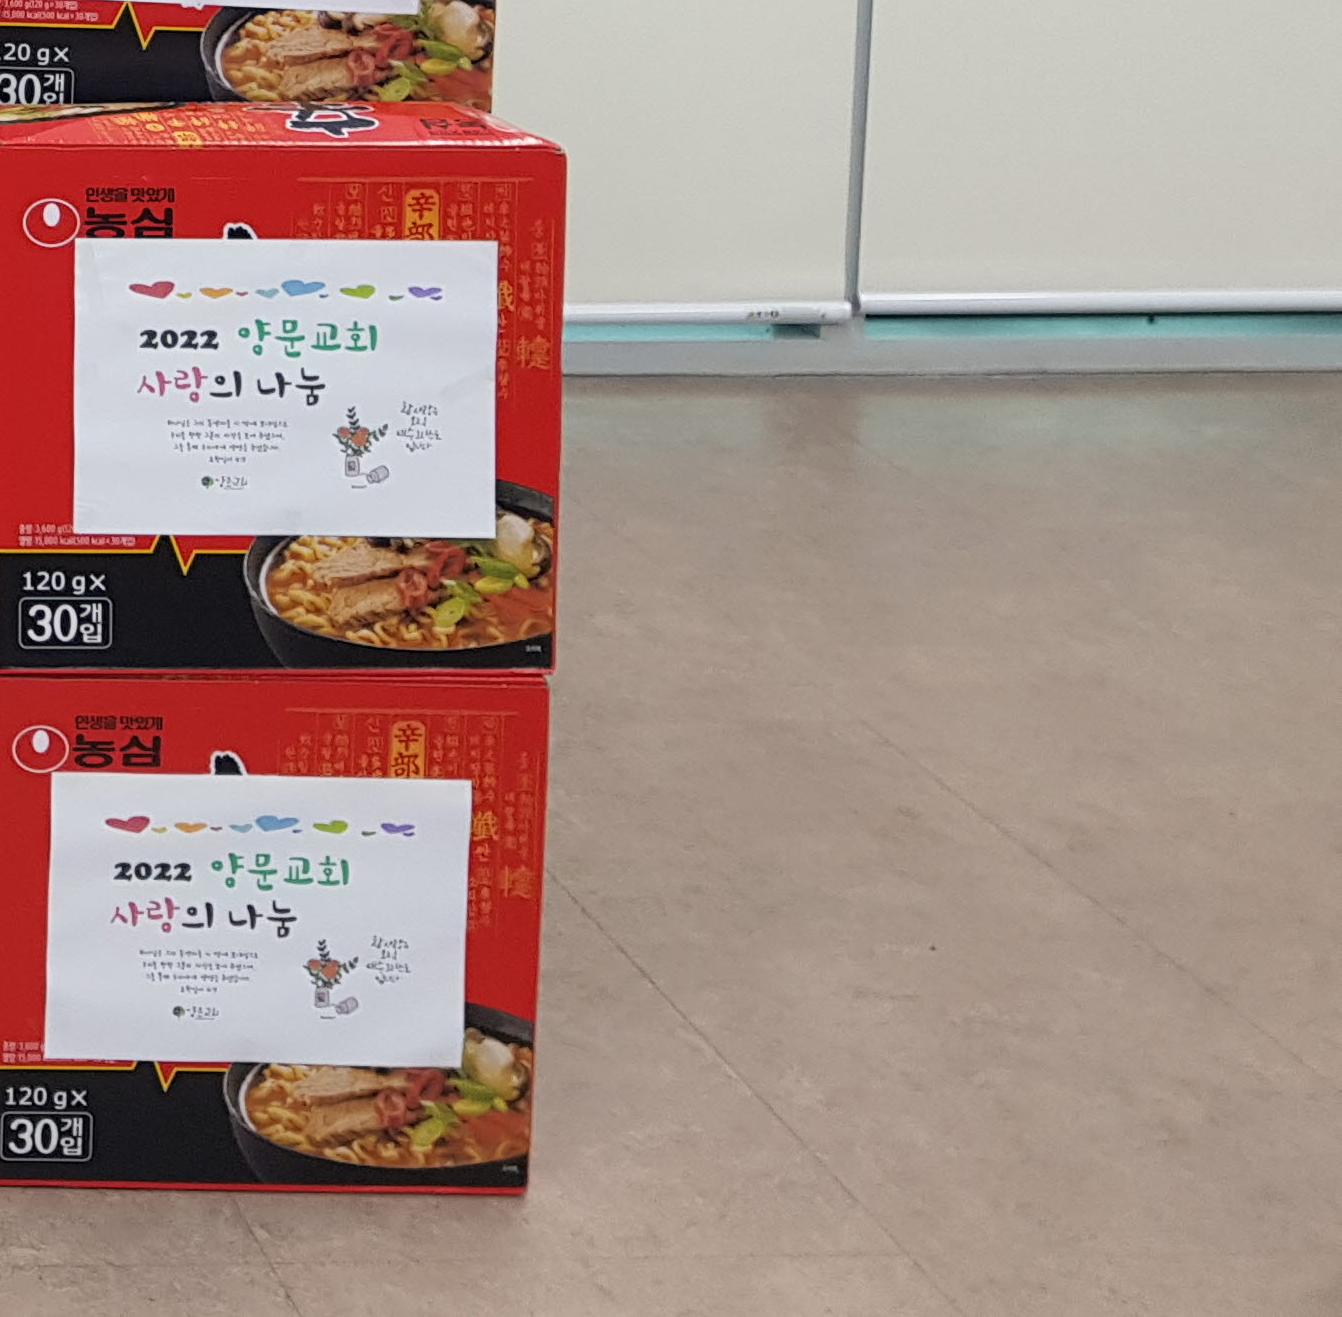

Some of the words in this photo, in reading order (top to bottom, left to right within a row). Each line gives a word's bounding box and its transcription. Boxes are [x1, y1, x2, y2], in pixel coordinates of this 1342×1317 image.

[84, 207, 174, 238] 농심
[139, 329, 220, 351] 2022
[237, 318, 378, 359] 양문교회
[137, 366, 242, 403] 사랑의
[256, 367, 326, 407] 나눔
[22, 572, 65, 591] 120
[72, 734, 162, 769] 농심
[113, 862, 192, 882] 2022
[210, 852, 350, 891] 양문교회
[110, 897, 214, 933] 사랑의
[228, 899, 298, 939] 나눔
[4, 1086, 47, 1106] 120
